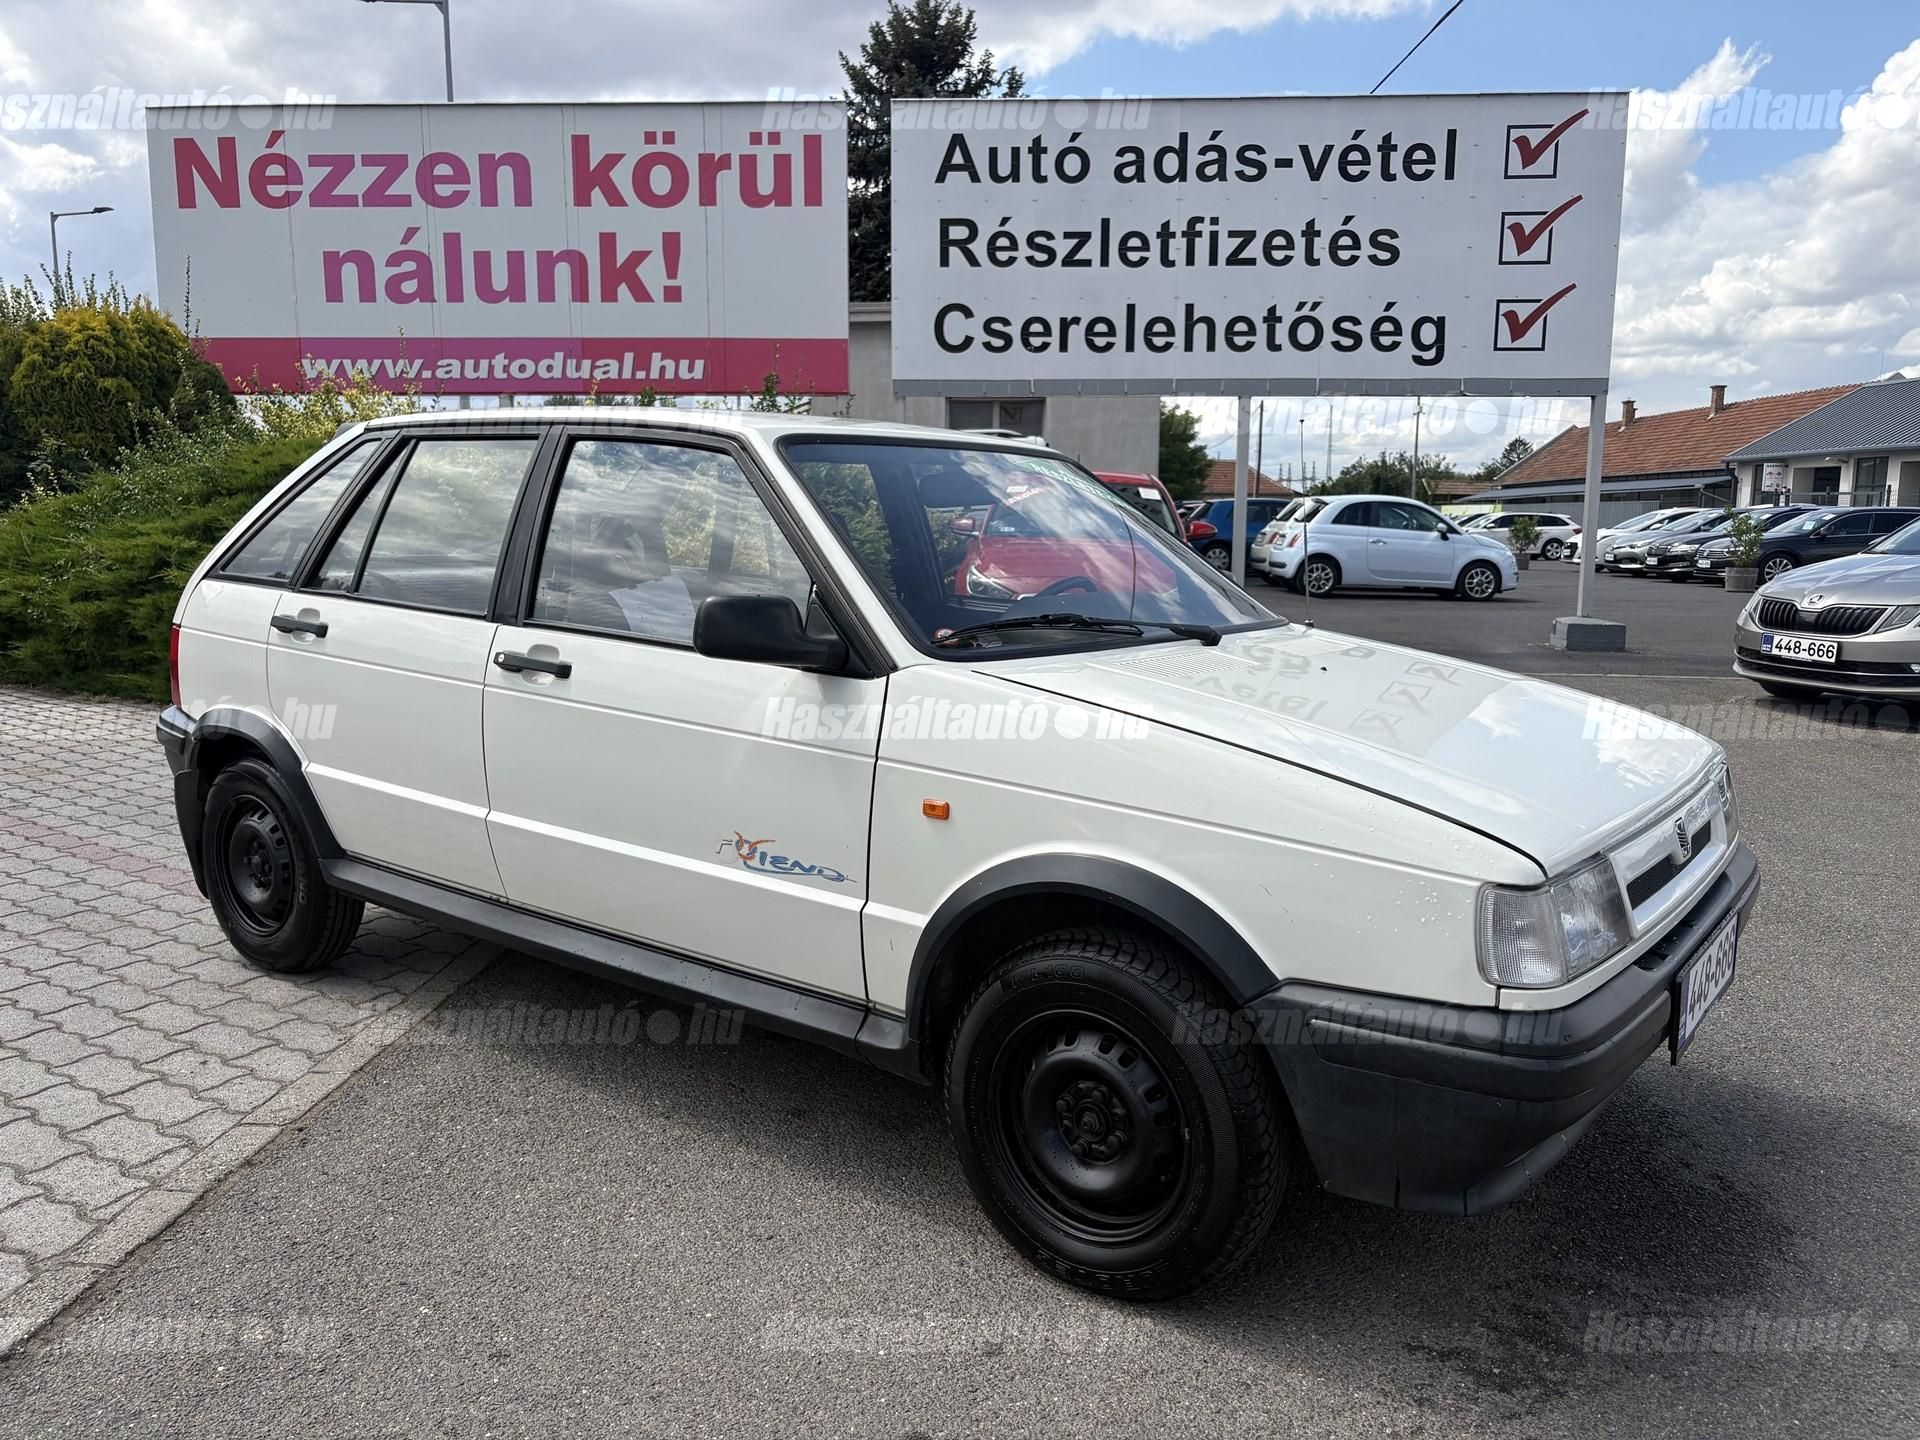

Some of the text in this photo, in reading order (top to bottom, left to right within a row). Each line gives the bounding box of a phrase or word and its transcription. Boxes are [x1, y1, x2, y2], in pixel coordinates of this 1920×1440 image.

[173, 130, 823, 209] Nézzen körül
[934, 128, 1458, 184] Autó adás-vétel
[322, 226, 683, 304] nálunk!
[938, 215, 1402, 269] Részletfizetés
[932, 300, 1448, 366] Cserelehetőség
[301, 352, 706, 381] www.autodual.hu
[1775, 638, 1836, 659] 448-666
